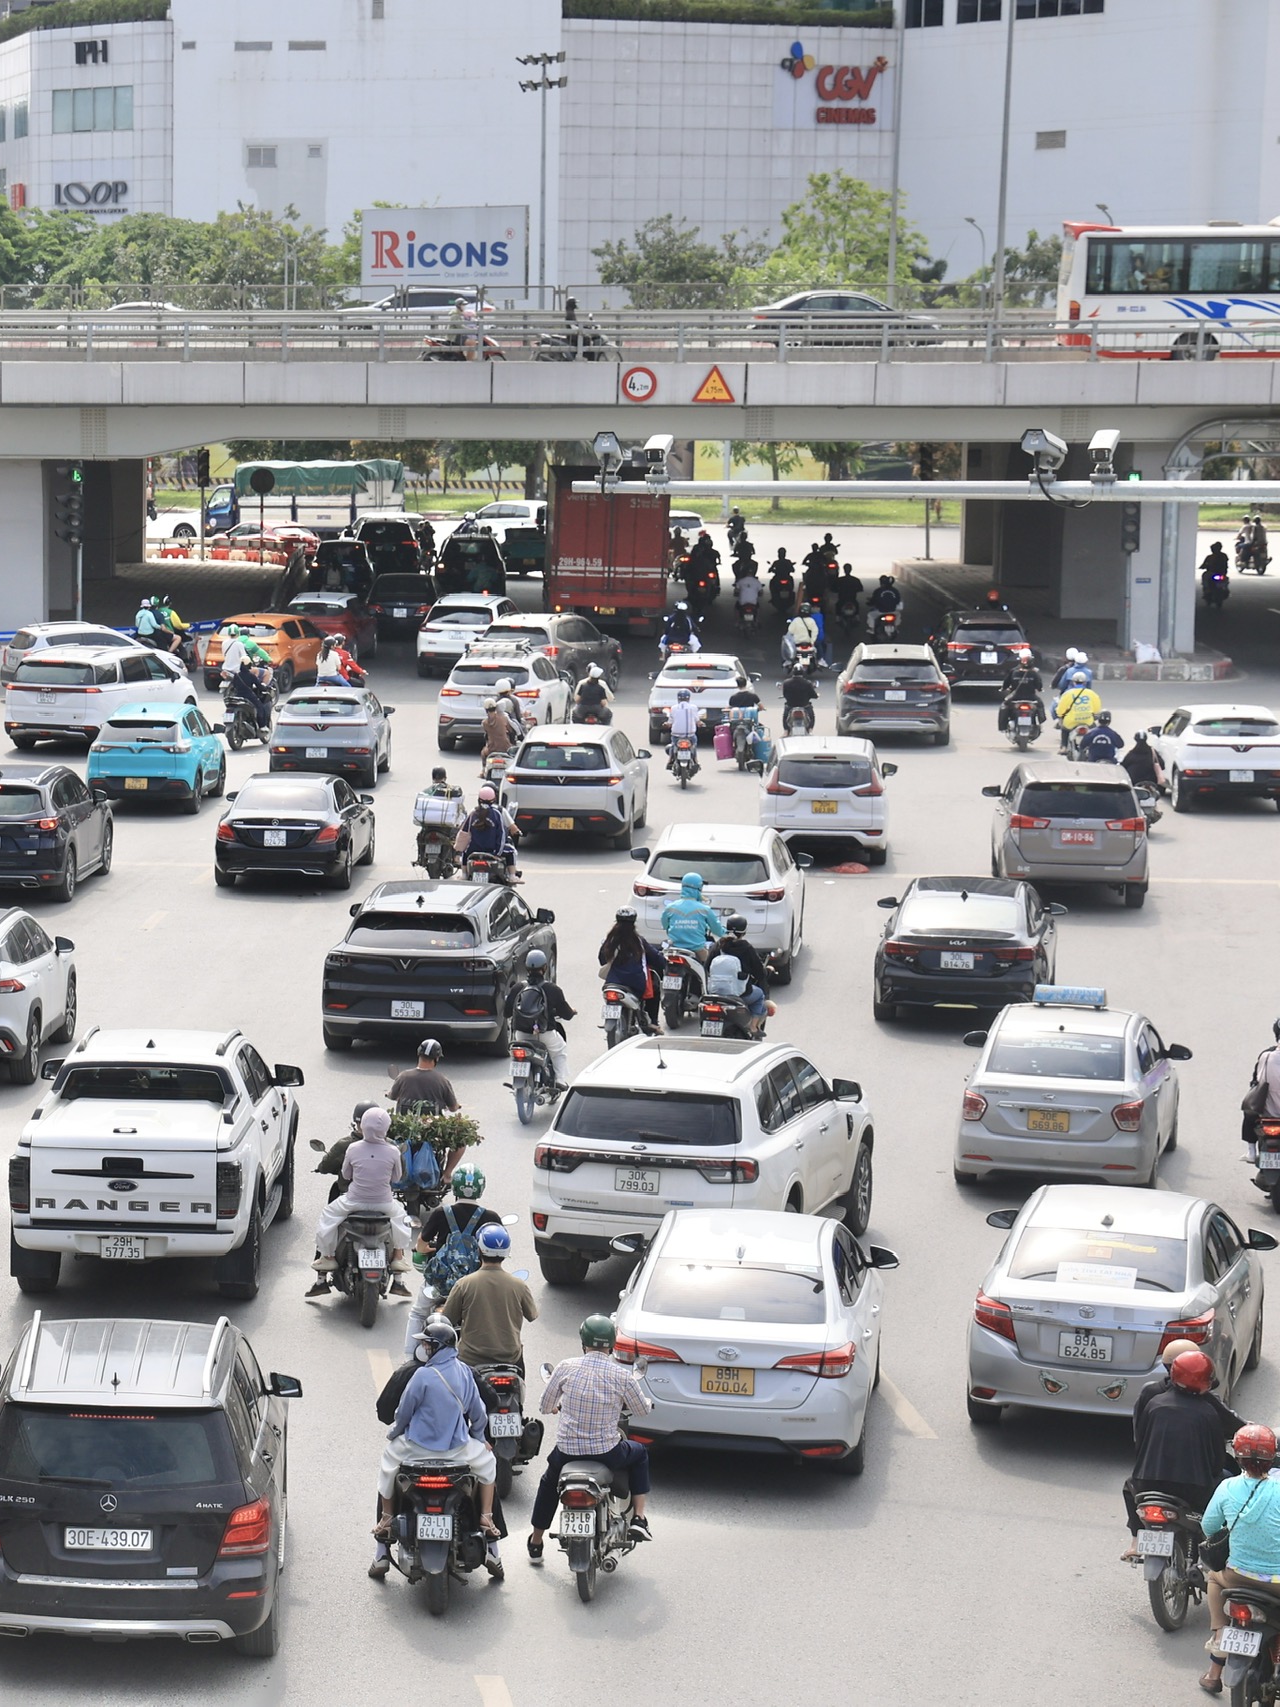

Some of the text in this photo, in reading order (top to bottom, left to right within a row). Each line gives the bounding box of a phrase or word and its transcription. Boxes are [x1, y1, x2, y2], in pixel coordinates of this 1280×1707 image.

[816, 65, 878, 101] CGV
[816, 107, 877, 125] CINEMAS
[55, 181, 128, 205] LOOP
[944, 960, 970, 969] 814.76
[401, 1001, 415, 1009] 30L
[394, 1008, 421, 1017] 553.38
[1040, 1112, 1057, 1121] 30E
[1032, 1120, 1065, 1131] 569.86
[589, 1153, 688, 1164] EVEREST
[628, 1170, 647, 1181] 30K
[620, 1180, 654, 1192] 799.03
[35, 1198, 212, 1213] RANGER
[113, 1237, 132, 1247] 29H
[105, 1247, 140, 1258] 577.35
[361, 1259, 384, 1267] 141.90
[1075, 1335, 1096, 1347] 89A
[1064, 1346, 1106, 1360] 624.85
[716, 1368, 739, 1381] 89H
[706, 1380, 748, 1394] 070.04
[492, 1425, 520, 1436] 067.61
[422, 1516, 447, 1528] 29-L1
[419, 1527, 450, 1540] 844.29
[564, 1523, 590, 1535] 7490
[67, 1529, 150, 1547] 30E-439.07
[1142, 1531, 1168, 1544] 89-AE
[1138, 1542, 1171, 1555] 043.79
[1226, 1629, 1255, 1643] 28-D1
[1222, 1640, 1256, 1655] 113.67
